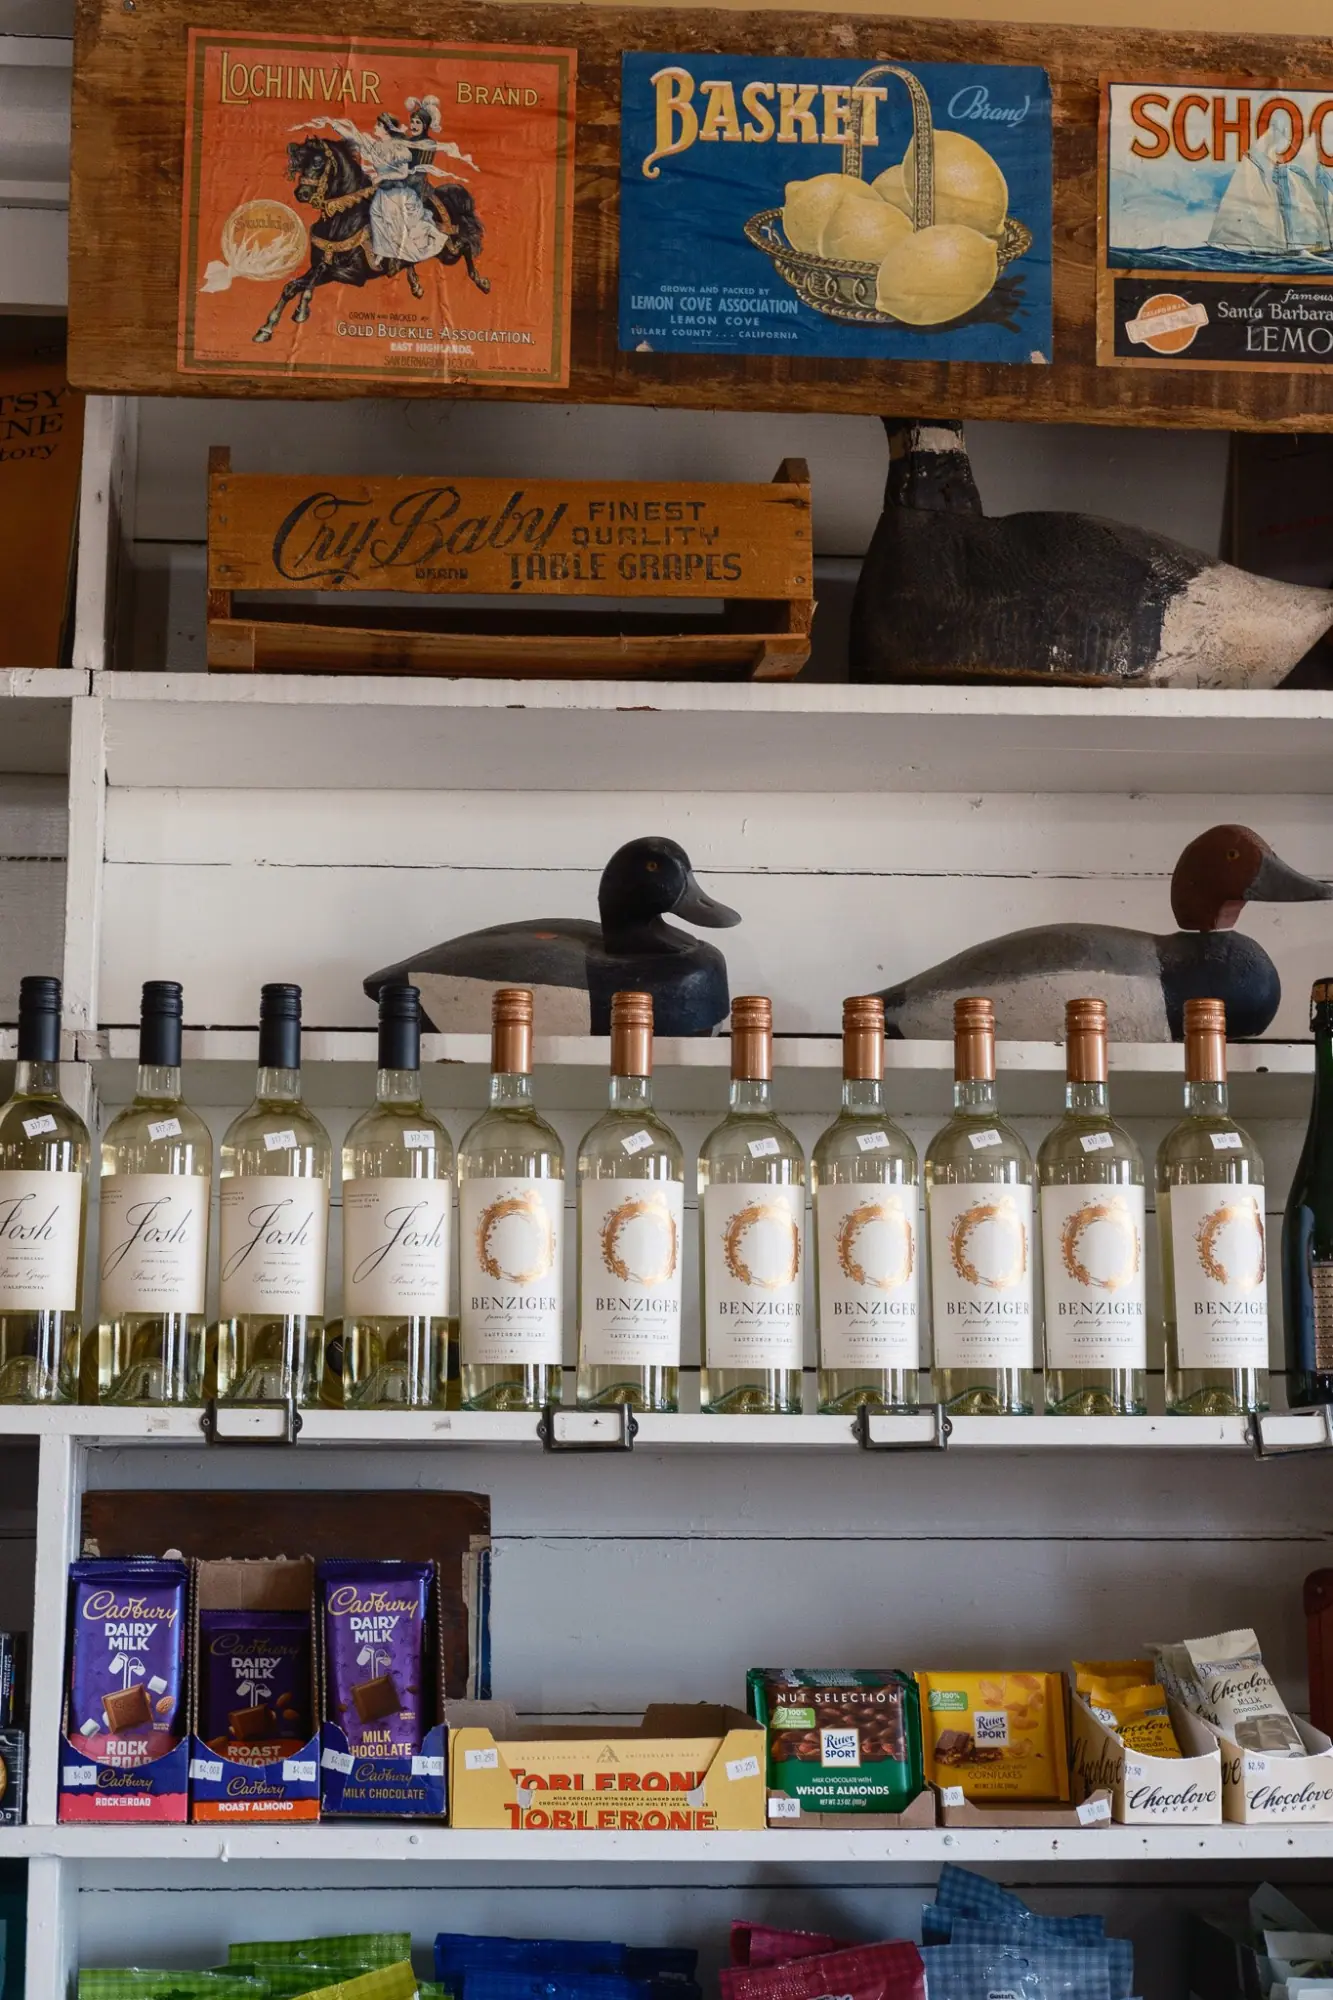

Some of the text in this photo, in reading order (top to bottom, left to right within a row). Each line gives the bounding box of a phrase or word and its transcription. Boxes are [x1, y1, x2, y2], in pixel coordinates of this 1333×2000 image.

[219, 51, 381, 104] LOCHINVAR
[456, 81, 539, 107] BRAND
[947, 85, 1030, 127] Brand
[642, 66, 887, 179] BASKET
[660, 285, 770, 296] GROWN AND PACKED BY
[1281, 289, 1333, 304] famous
[631, 295, 798, 315] LEMON COVE ASSOCIATION
[1217, 302, 1333, 322] Santa Barbara
[349, 312, 417, 321] GROWN PACKED
[670, 315, 760, 326] LEMON COVE
[337, 321, 373, 337] GOLD
[378, 323, 433, 340] BUCKLE
[631, 327, 798, 339] TULARE COUNTY CALIFORNIA
[390, 342, 413, 352] EAST
[588, 502, 706, 522] FINEST
[271, 485, 567, 586] Cry Baby
[571, 526, 720, 546] QUALITY
[415, 567, 468, 579] BRAND
[509, 552, 742, 583] TABLE GRAPES
[0, 1193, 60, 1242] Josh
[102, 1197, 193, 1281] Josh
[222, 1199, 314, 1282] Josh
[352, 1201, 445, 1285] Josh
[471, 1296, 556, 1310] BENZIGER
[595, 1297, 679, 1313] BENZIGER
[719, 1301, 801, 1316] BENZIGER
[833, 1301, 917, 1316] BENZIGER
[947, 1301, 1030, 1315] BENZIGER
[1058, 1301, 1143, 1315] BENZIGER
[484, 1313, 513, 1322] family
[611, 1314, 639, 1323] family
[734, 1318, 763, 1327] family
[849, 1318, 877, 1327] family
[962, 1318, 991, 1327] family
[1073, 1318, 1103, 1327] family
[1211, 1319, 1240, 1327] family
[82, 1590, 180, 1628] Cadbury
[327, 1586, 419, 1619] Cadbury
[350, 1615, 400, 1630] DAIRY
[105, 1623, 157, 1637] DAIRY
[354, 1629, 394, 1643] MILK
[108, 1637, 150, 1651] MILK
[210, 1633, 300, 1657] Cadbury
[231, 1657, 282, 1668] DAIRY
[235, 1668, 275, 1679] MILK
[1210, 1671, 1274, 1704] Chocolove
[777, 1693, 898, 1703] NUT SELECTION
[1237, 1697, 1261, 1706] Milk
[1233, 1703, 1273, 1714] Chocolate
[976, 1715, 1005, 1730] Ritter
[1115, 1720, 1172, 1734] hocolove
[362, 1730, 391, 1743] MILK
[824, 1734, 856, 1748] Ritter
[977, 1731, 1006, 1739] SPORT
[106, 1740, 148, 1755] ROCK
[227, 1745, 281, 1757] ROAST
[349, 1742, 412, 1757] HOCOLATE
[825, 1750, 856, 1758] SPORT
[355, 1763, 413, 1783] Cadbury
[1248, 1761, 1265, 1771] $2.50
[97, 1769, 153, 1790] Cadbury
[968, 1770, 1023, 1780] CORNFLAKES
[226, 1776, 286, 1797] Cadbury
[796, 1786, 889, 1795] WHOLE ALMONDS
[342, 1788, 424, 1800] MILK CHOCOLATE
[1126, 1783, 1217, 1811] Chocolove
[1246, 1782, 1333, 1811] Chocolove
[95, 1798, 119, 1807] ROCK
[127, 1798, 151, 1807] ROAD
[218, 1802, 294, 1812] ROAST ALMOND
[777, 1803, 796, 1812] $5.00
[504, 1803, 717, 1829] TOBLERONE
